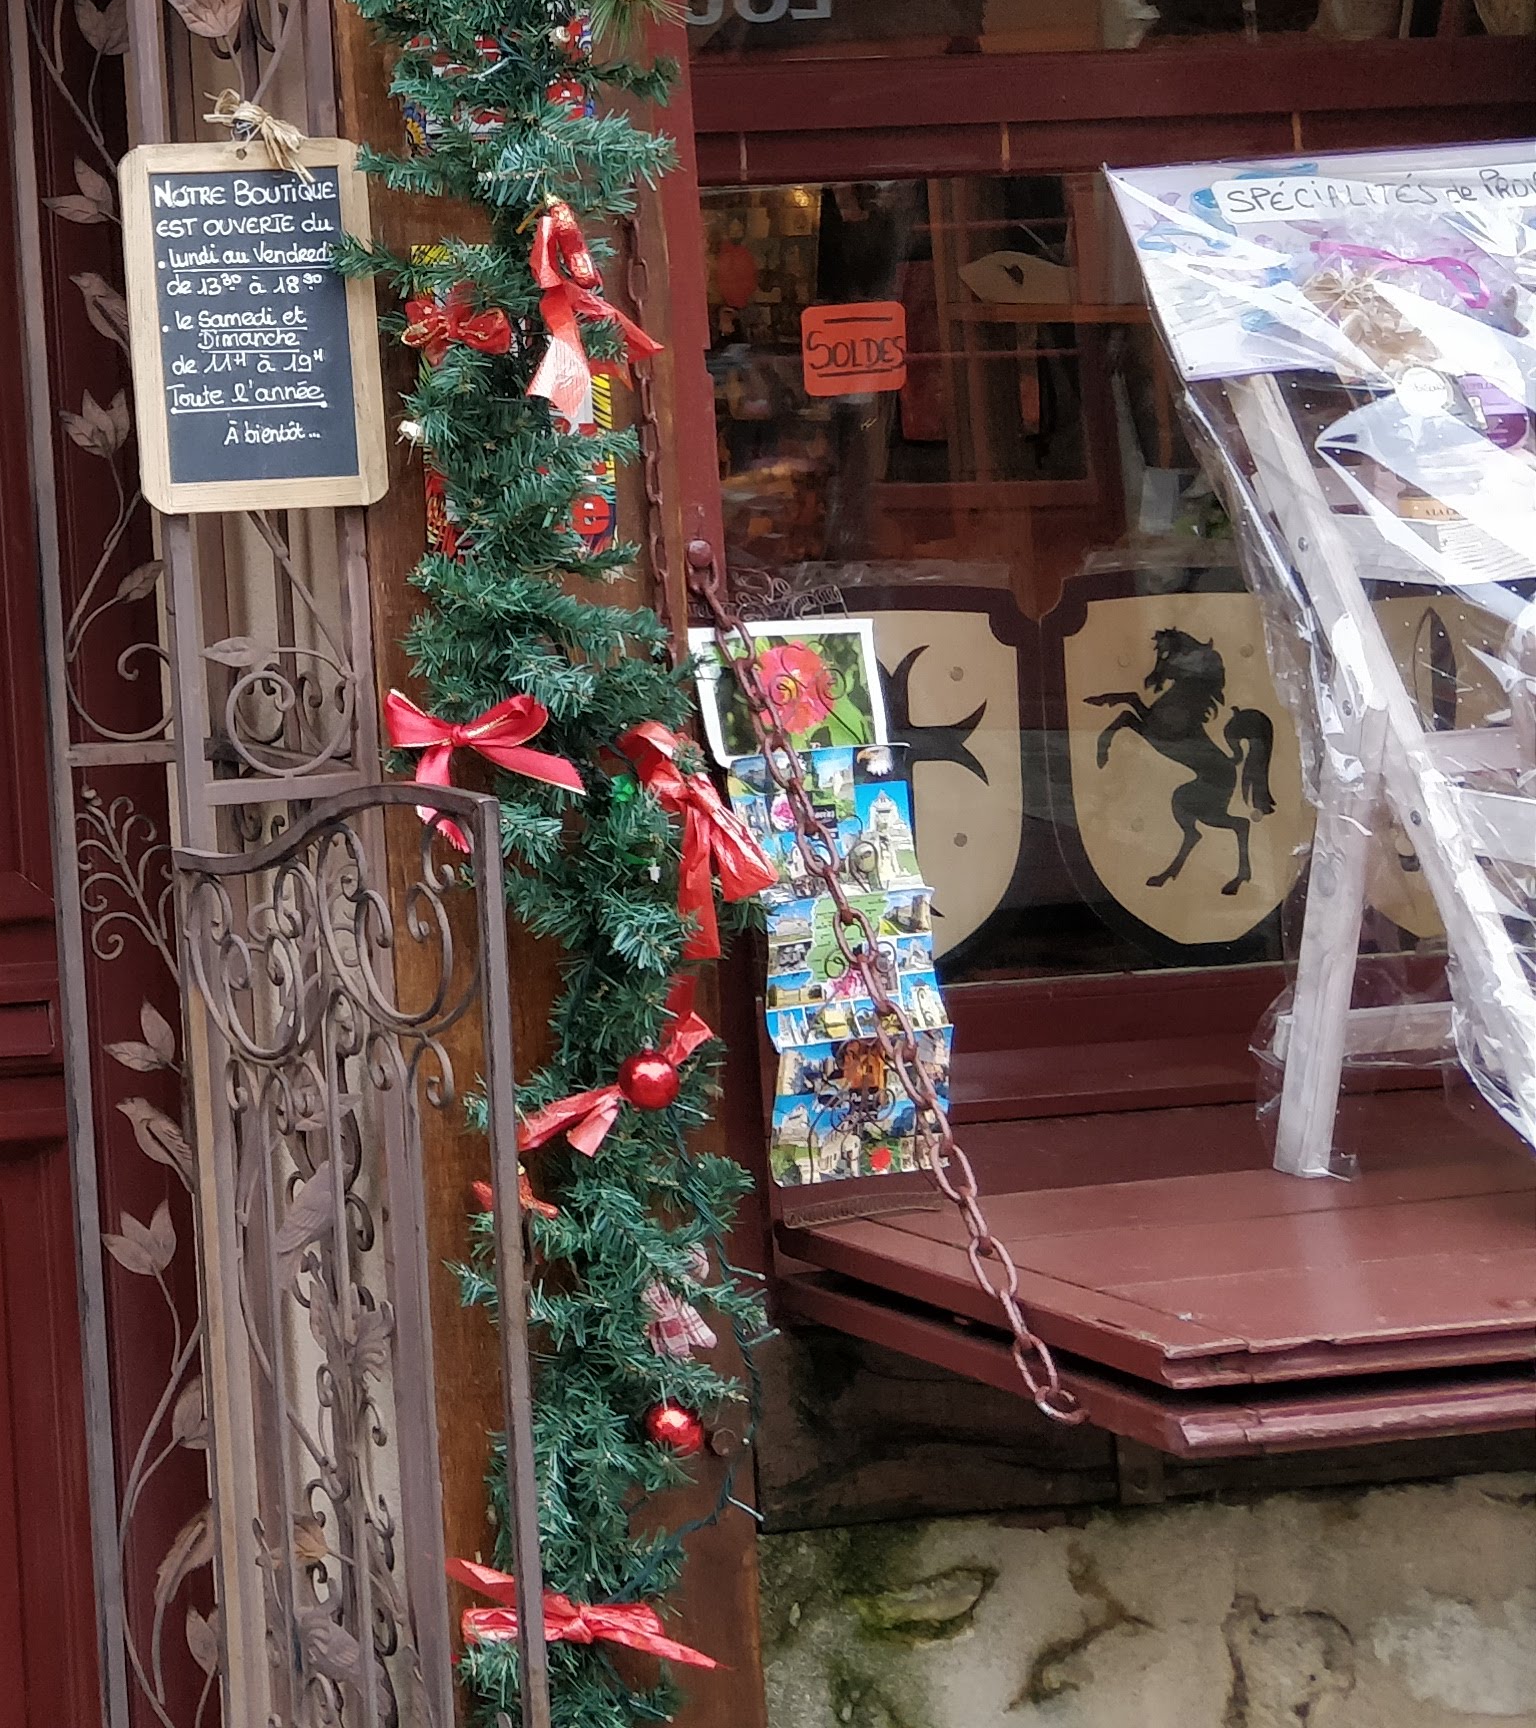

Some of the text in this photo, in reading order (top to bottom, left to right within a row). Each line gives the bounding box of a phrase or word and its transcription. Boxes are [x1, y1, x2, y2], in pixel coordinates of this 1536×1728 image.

[1445, 179, 1478, 204] de
[156, 212, 334, 238] EST OUVERTE du
[222, 251, 249, 266] au
[166, 275, 192, 297] de
[249, 276, 267, 296] à
[174, 306, 307, 331] le Samedi et
[197, 329, 300, 350] Dimanche
[806, 330, 906, 370] SOLDES
[172, 354, 196, 376] de
[257, 353, 276, 373] à
[167, 383, 224, 409] Toute
